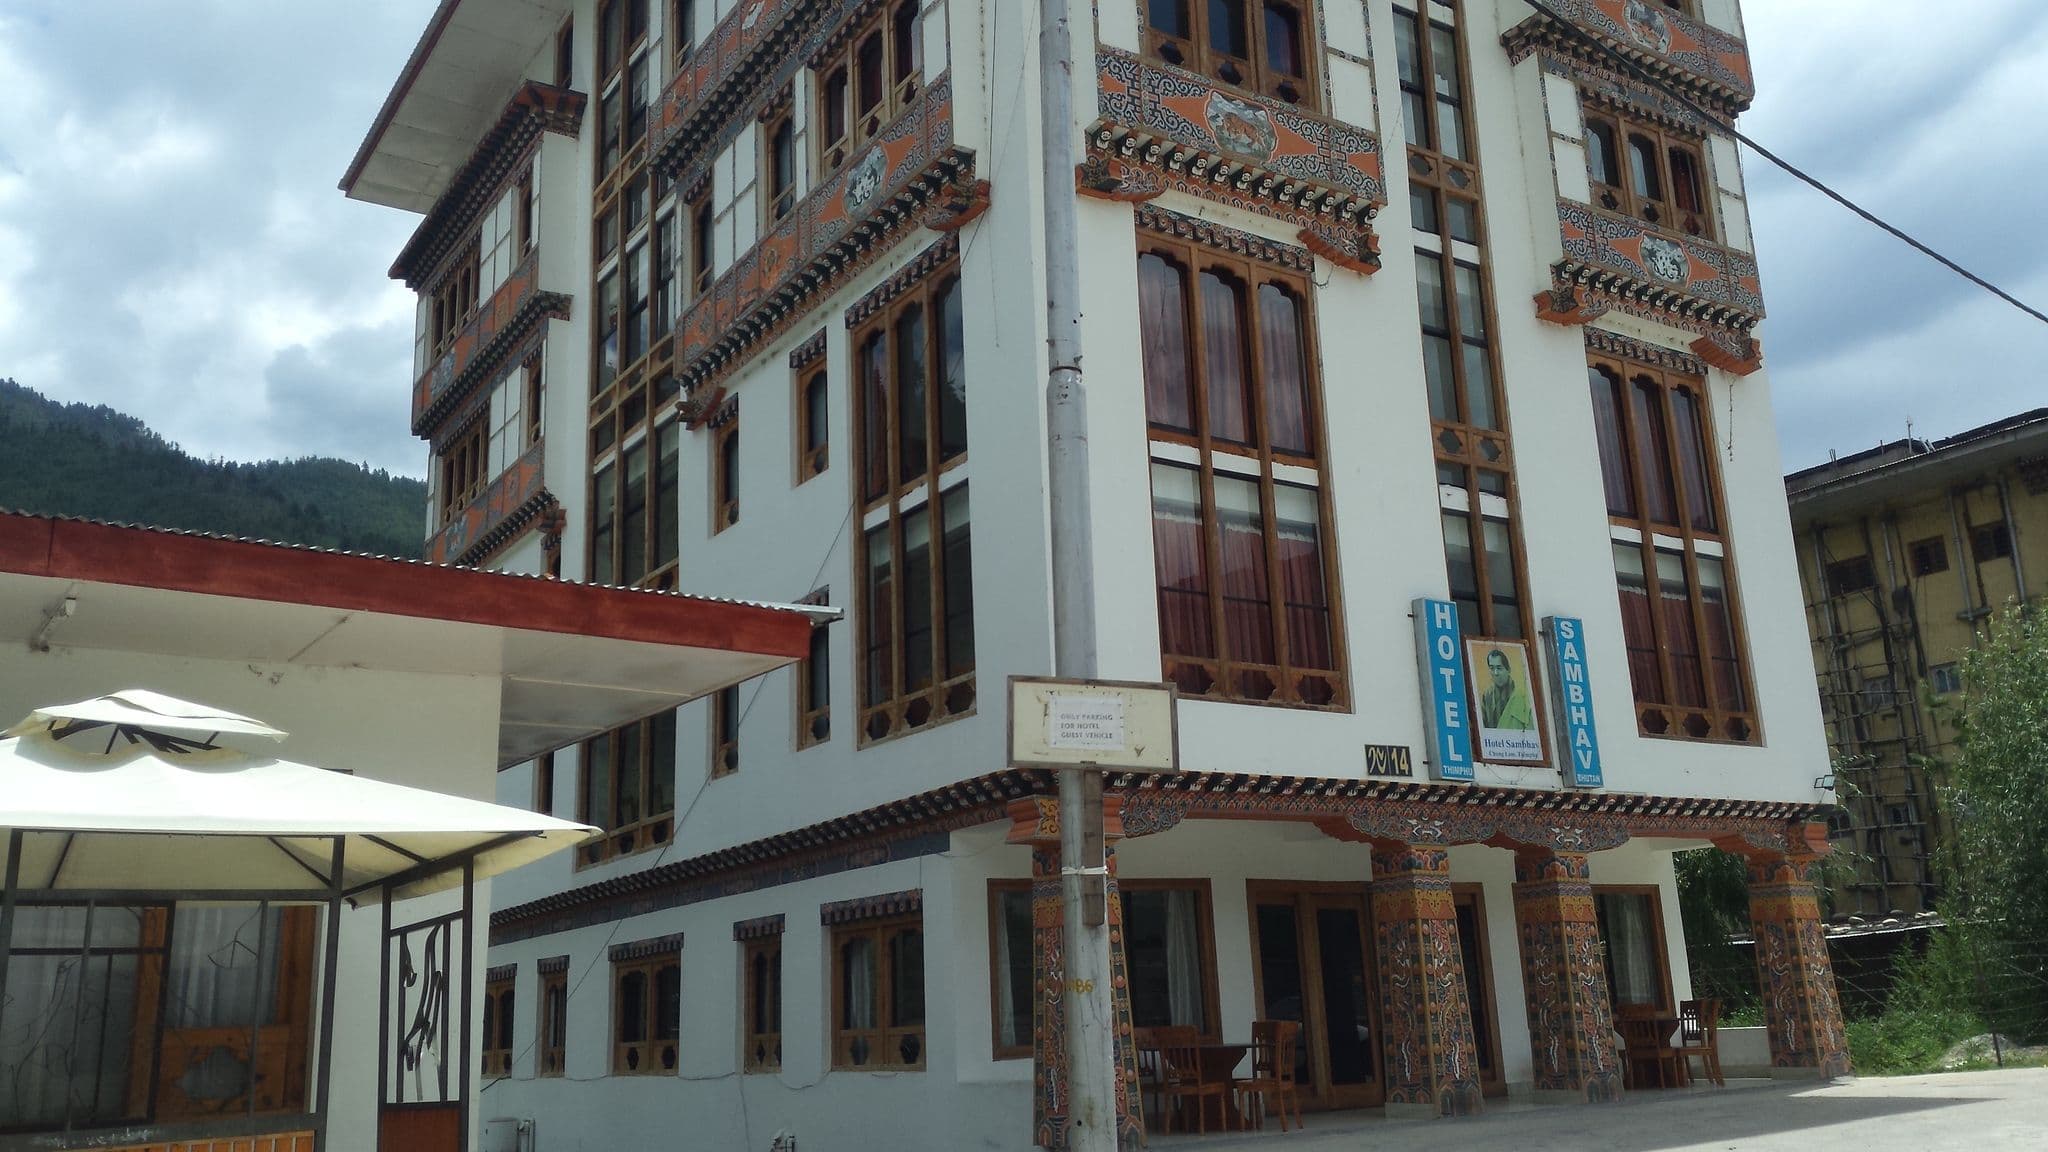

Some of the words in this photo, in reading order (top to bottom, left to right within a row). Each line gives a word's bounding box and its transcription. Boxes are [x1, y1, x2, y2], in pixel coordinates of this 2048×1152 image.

[1434, 602, 1463, 762] HOTEL
[1559, 620, 1592, 769] SAMBHAV
[1484, 739, 1505, 748] Hotel
[1506, 739, 1539, 749] Sambhav
[1442, 765, 1473, 776] THIMPHU
[1576, 774, 1601, 783] BHUTAN
